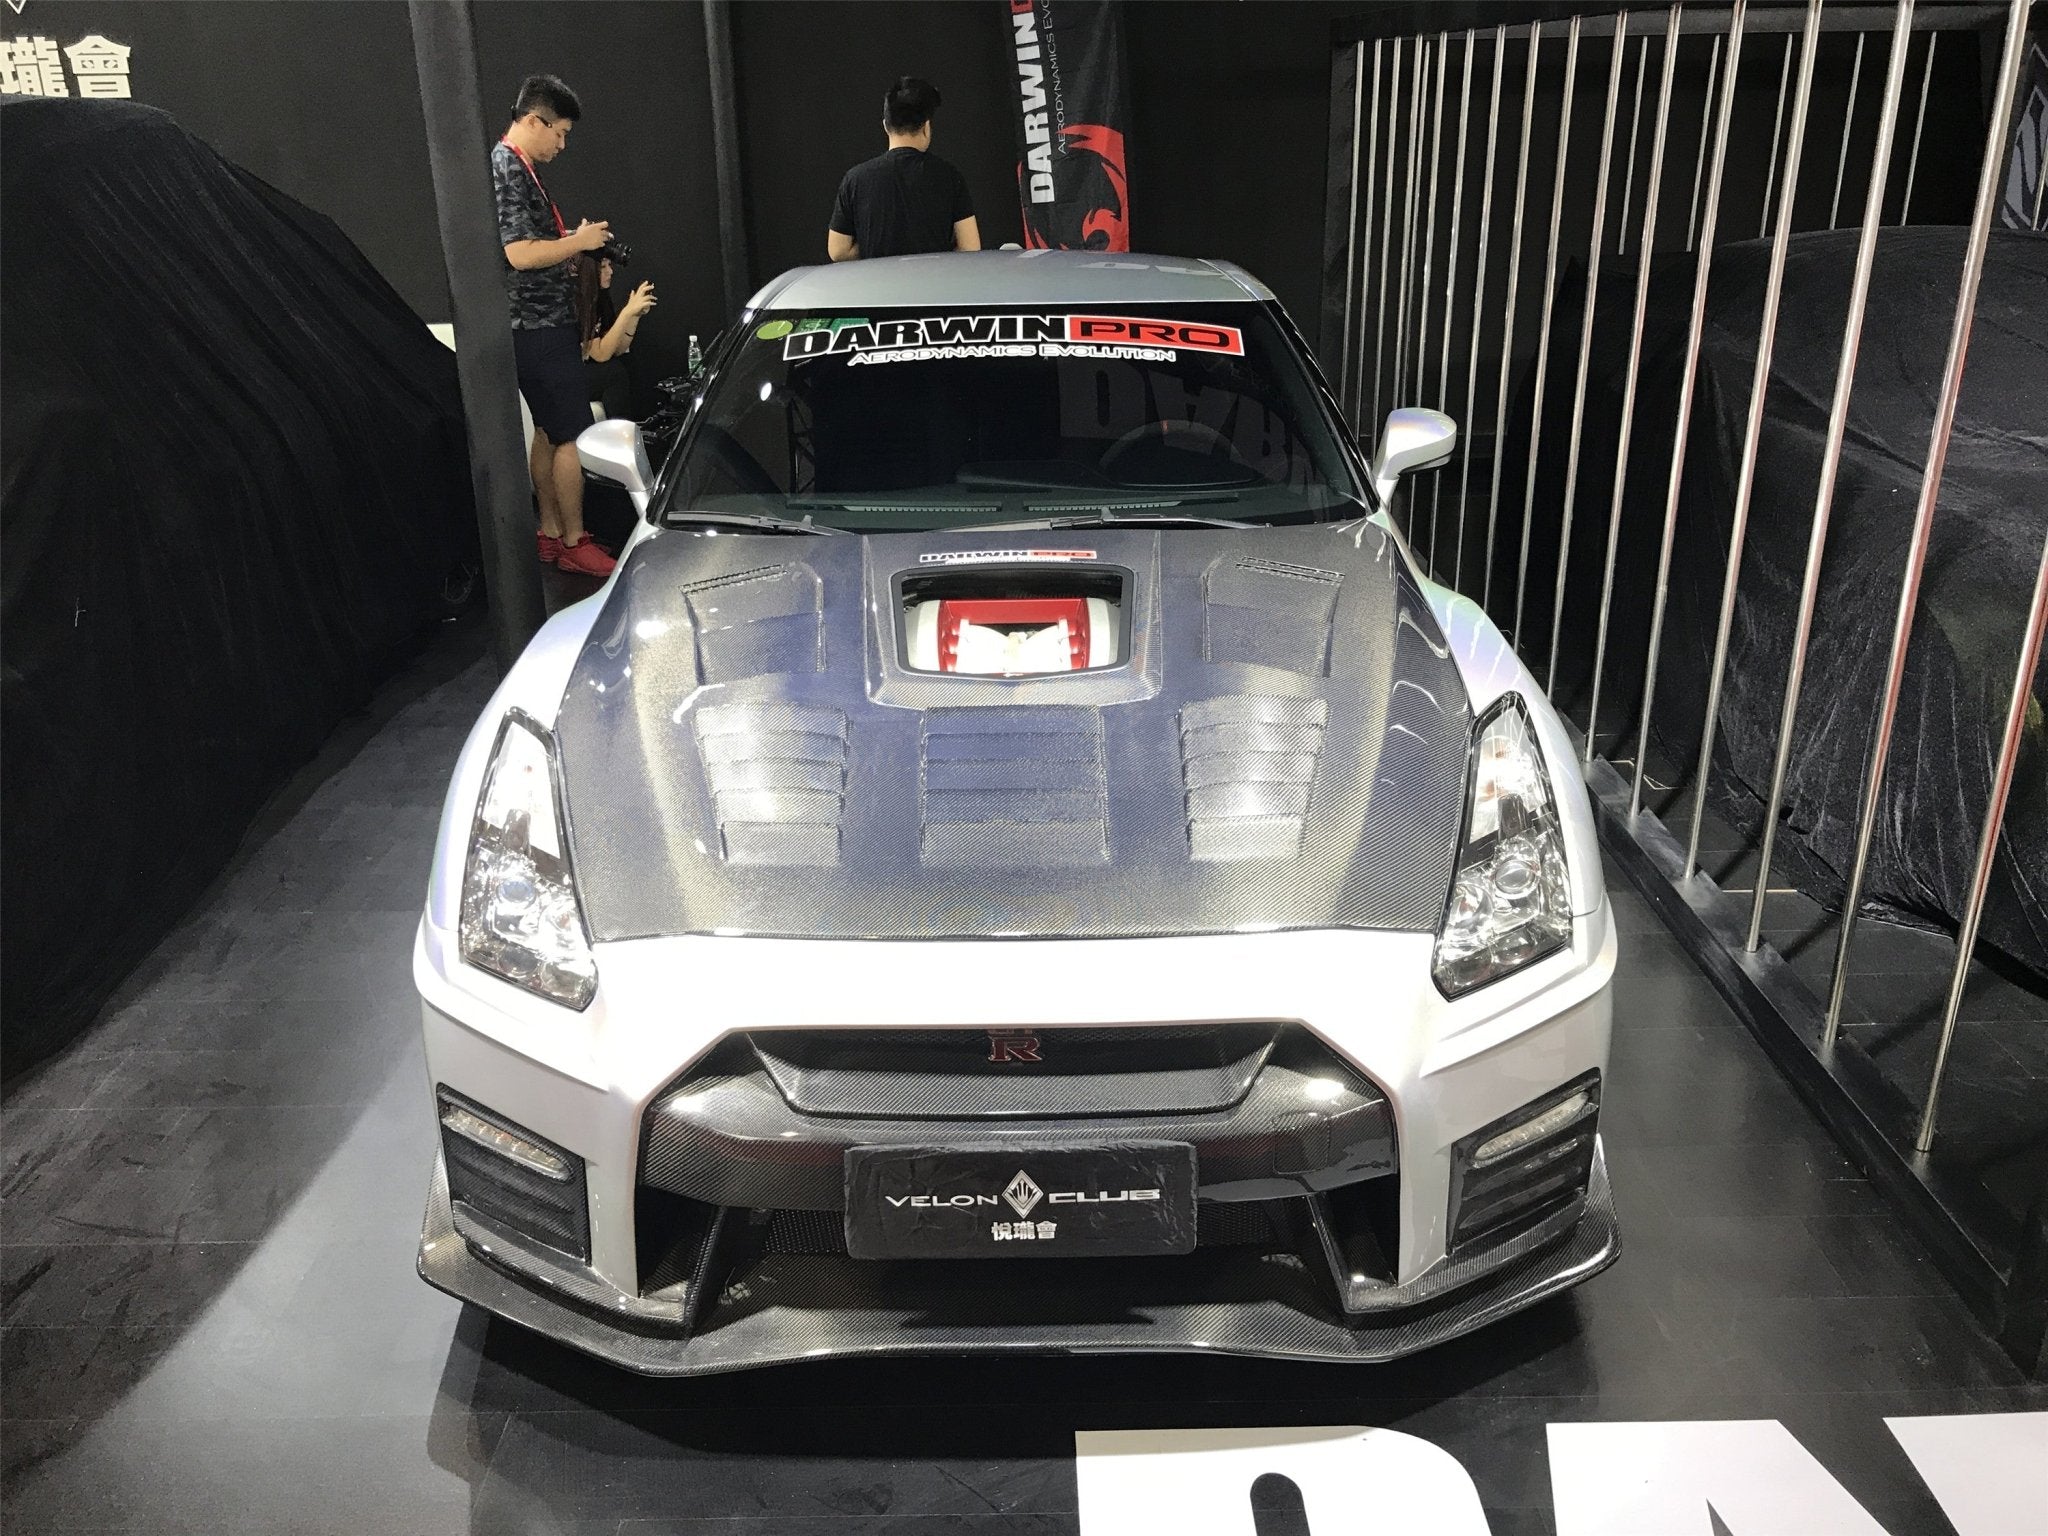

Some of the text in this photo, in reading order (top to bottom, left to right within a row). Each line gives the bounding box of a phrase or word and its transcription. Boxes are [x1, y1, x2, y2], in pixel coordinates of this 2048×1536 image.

[1012, 12, 1055, 204] DARWIN
[1047, 32, 1068, 155] AERODYNAMICS
[847, 344, 1176, 366] AERODYNAMICS EVOLUTION
[885, 1189, 1160, 1207] VELON CLUB
